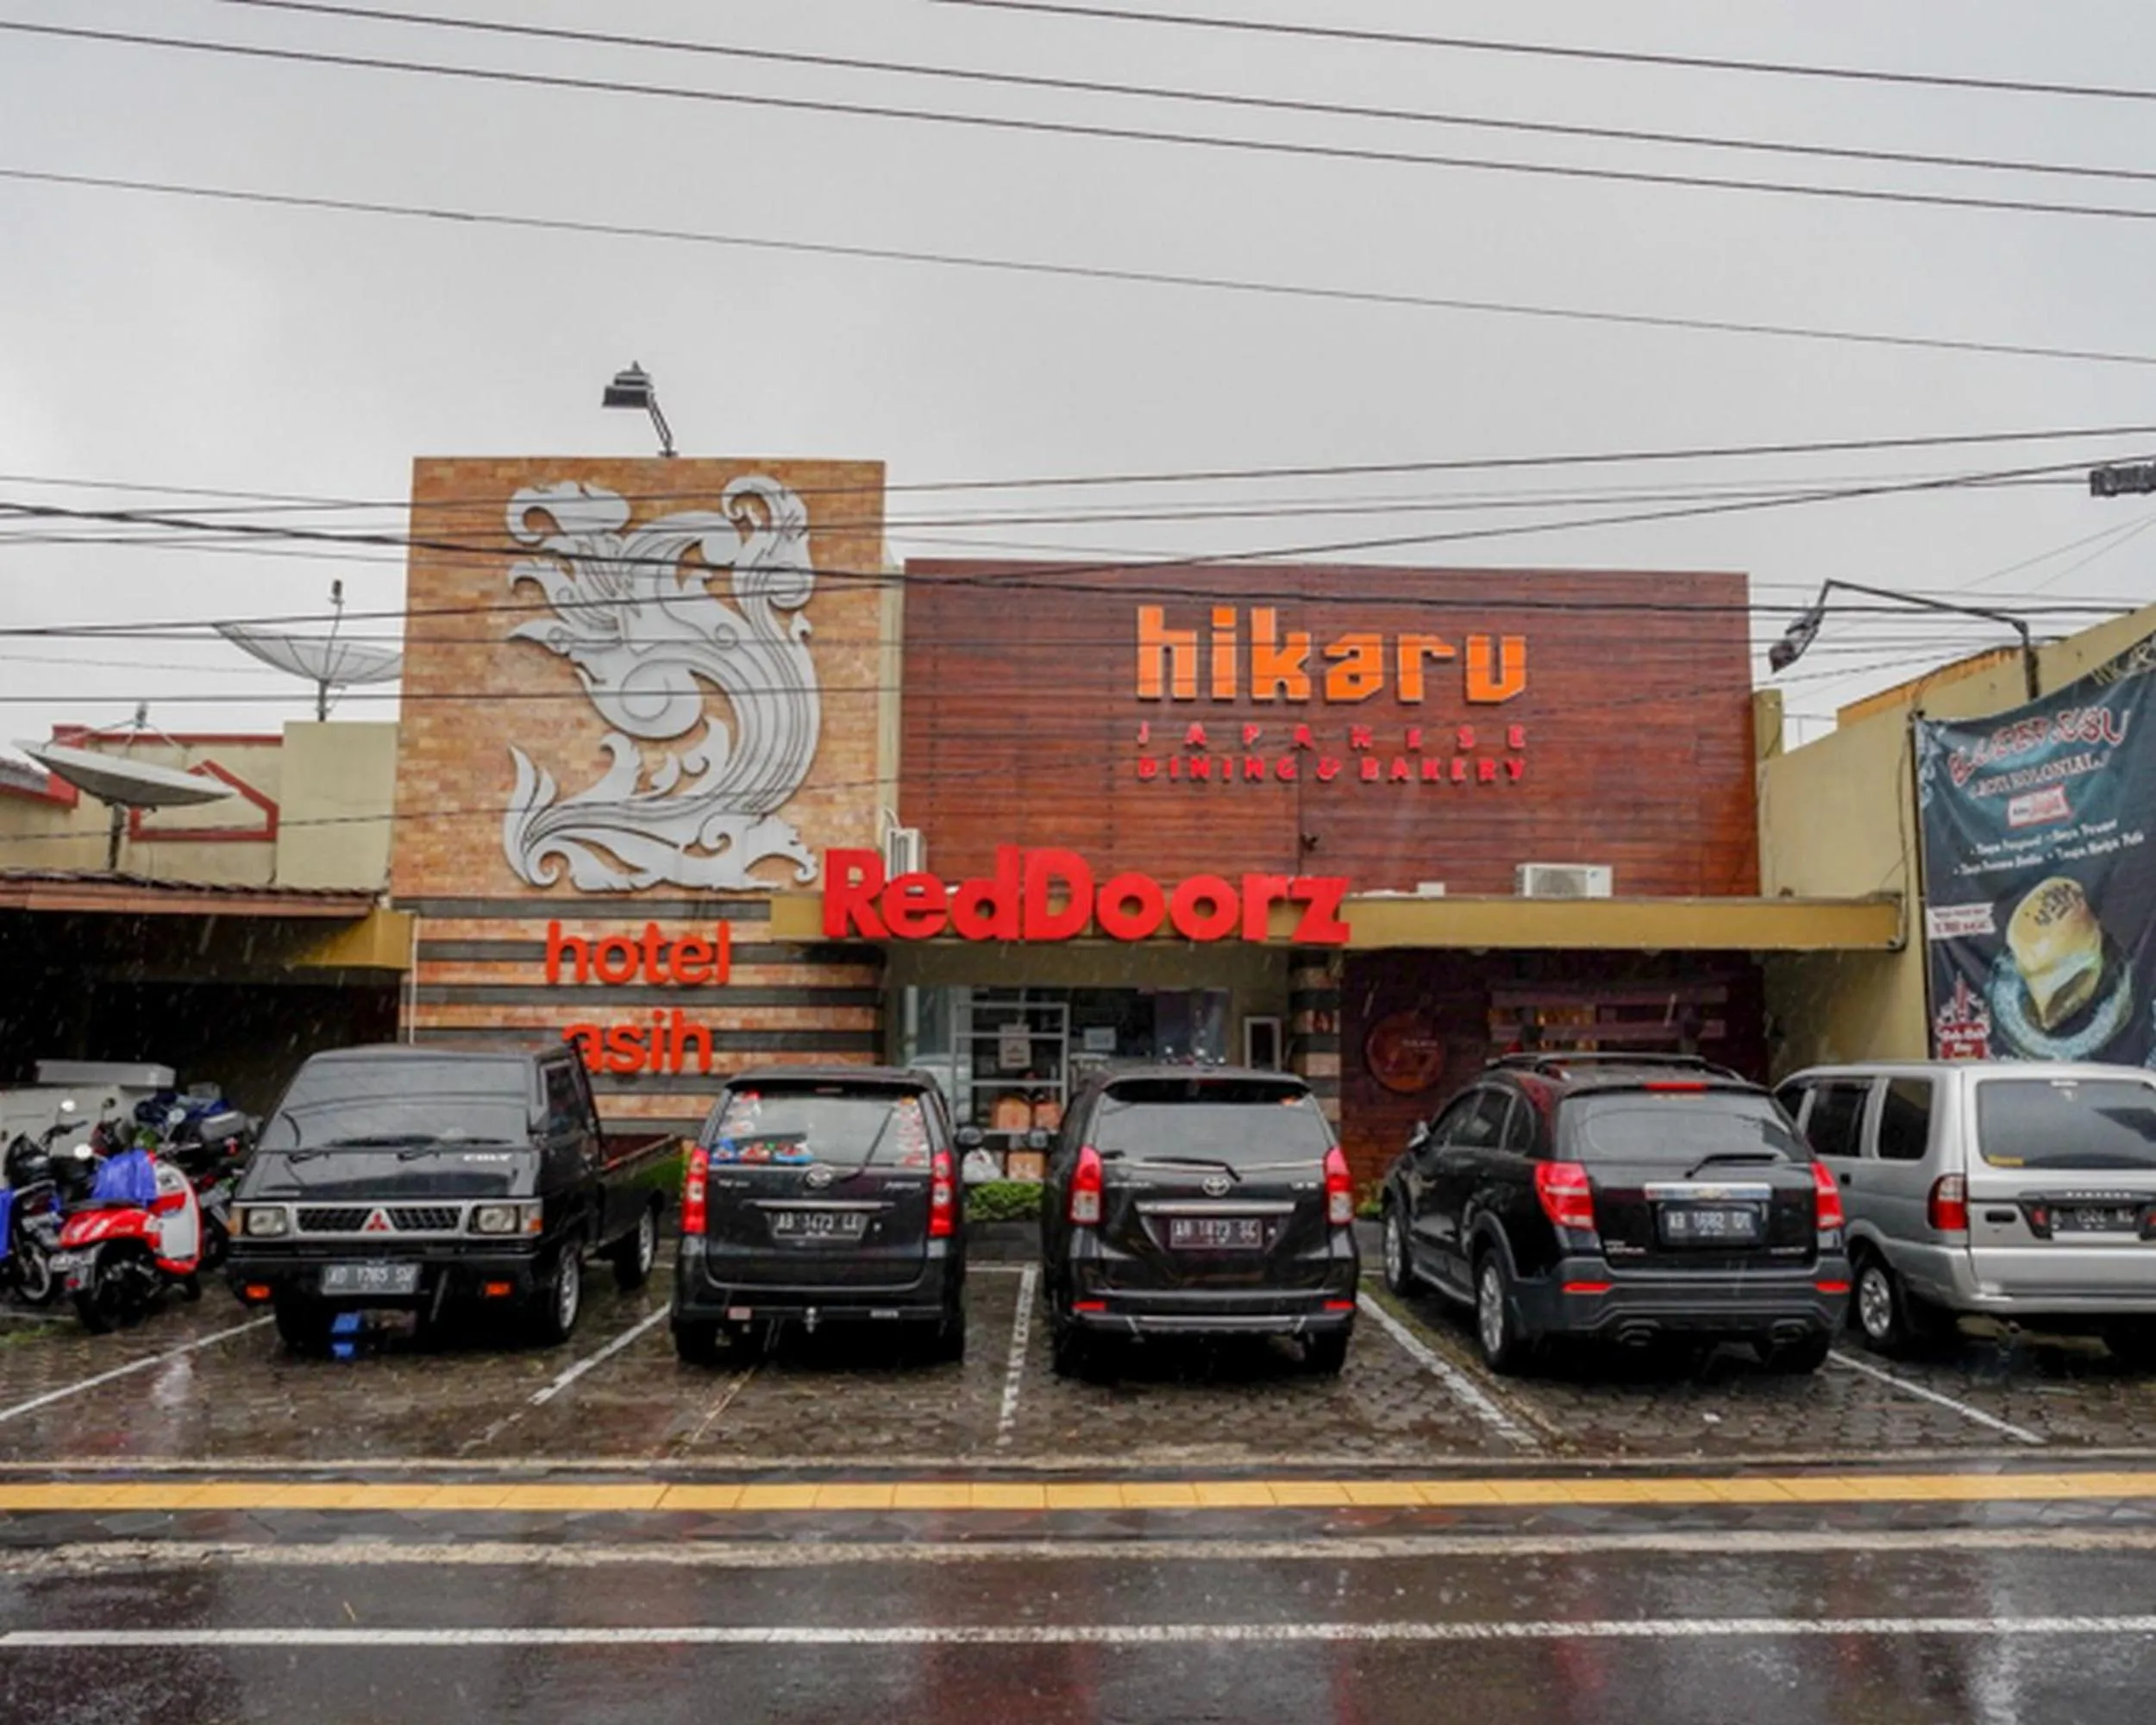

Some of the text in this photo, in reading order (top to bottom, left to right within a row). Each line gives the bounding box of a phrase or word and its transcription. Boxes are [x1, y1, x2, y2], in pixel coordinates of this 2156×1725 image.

[1137, 605, 1526, 701] hikaru
[1137, 720, 1526, 750] JAPANESE
[1138, 756, 1526, 784] DINING & BAKERY
[822, 844, 1351, 944] RedDoorz
[545, 919, 731, 986] hotel
[561, 1008, 713, 1075] asih
